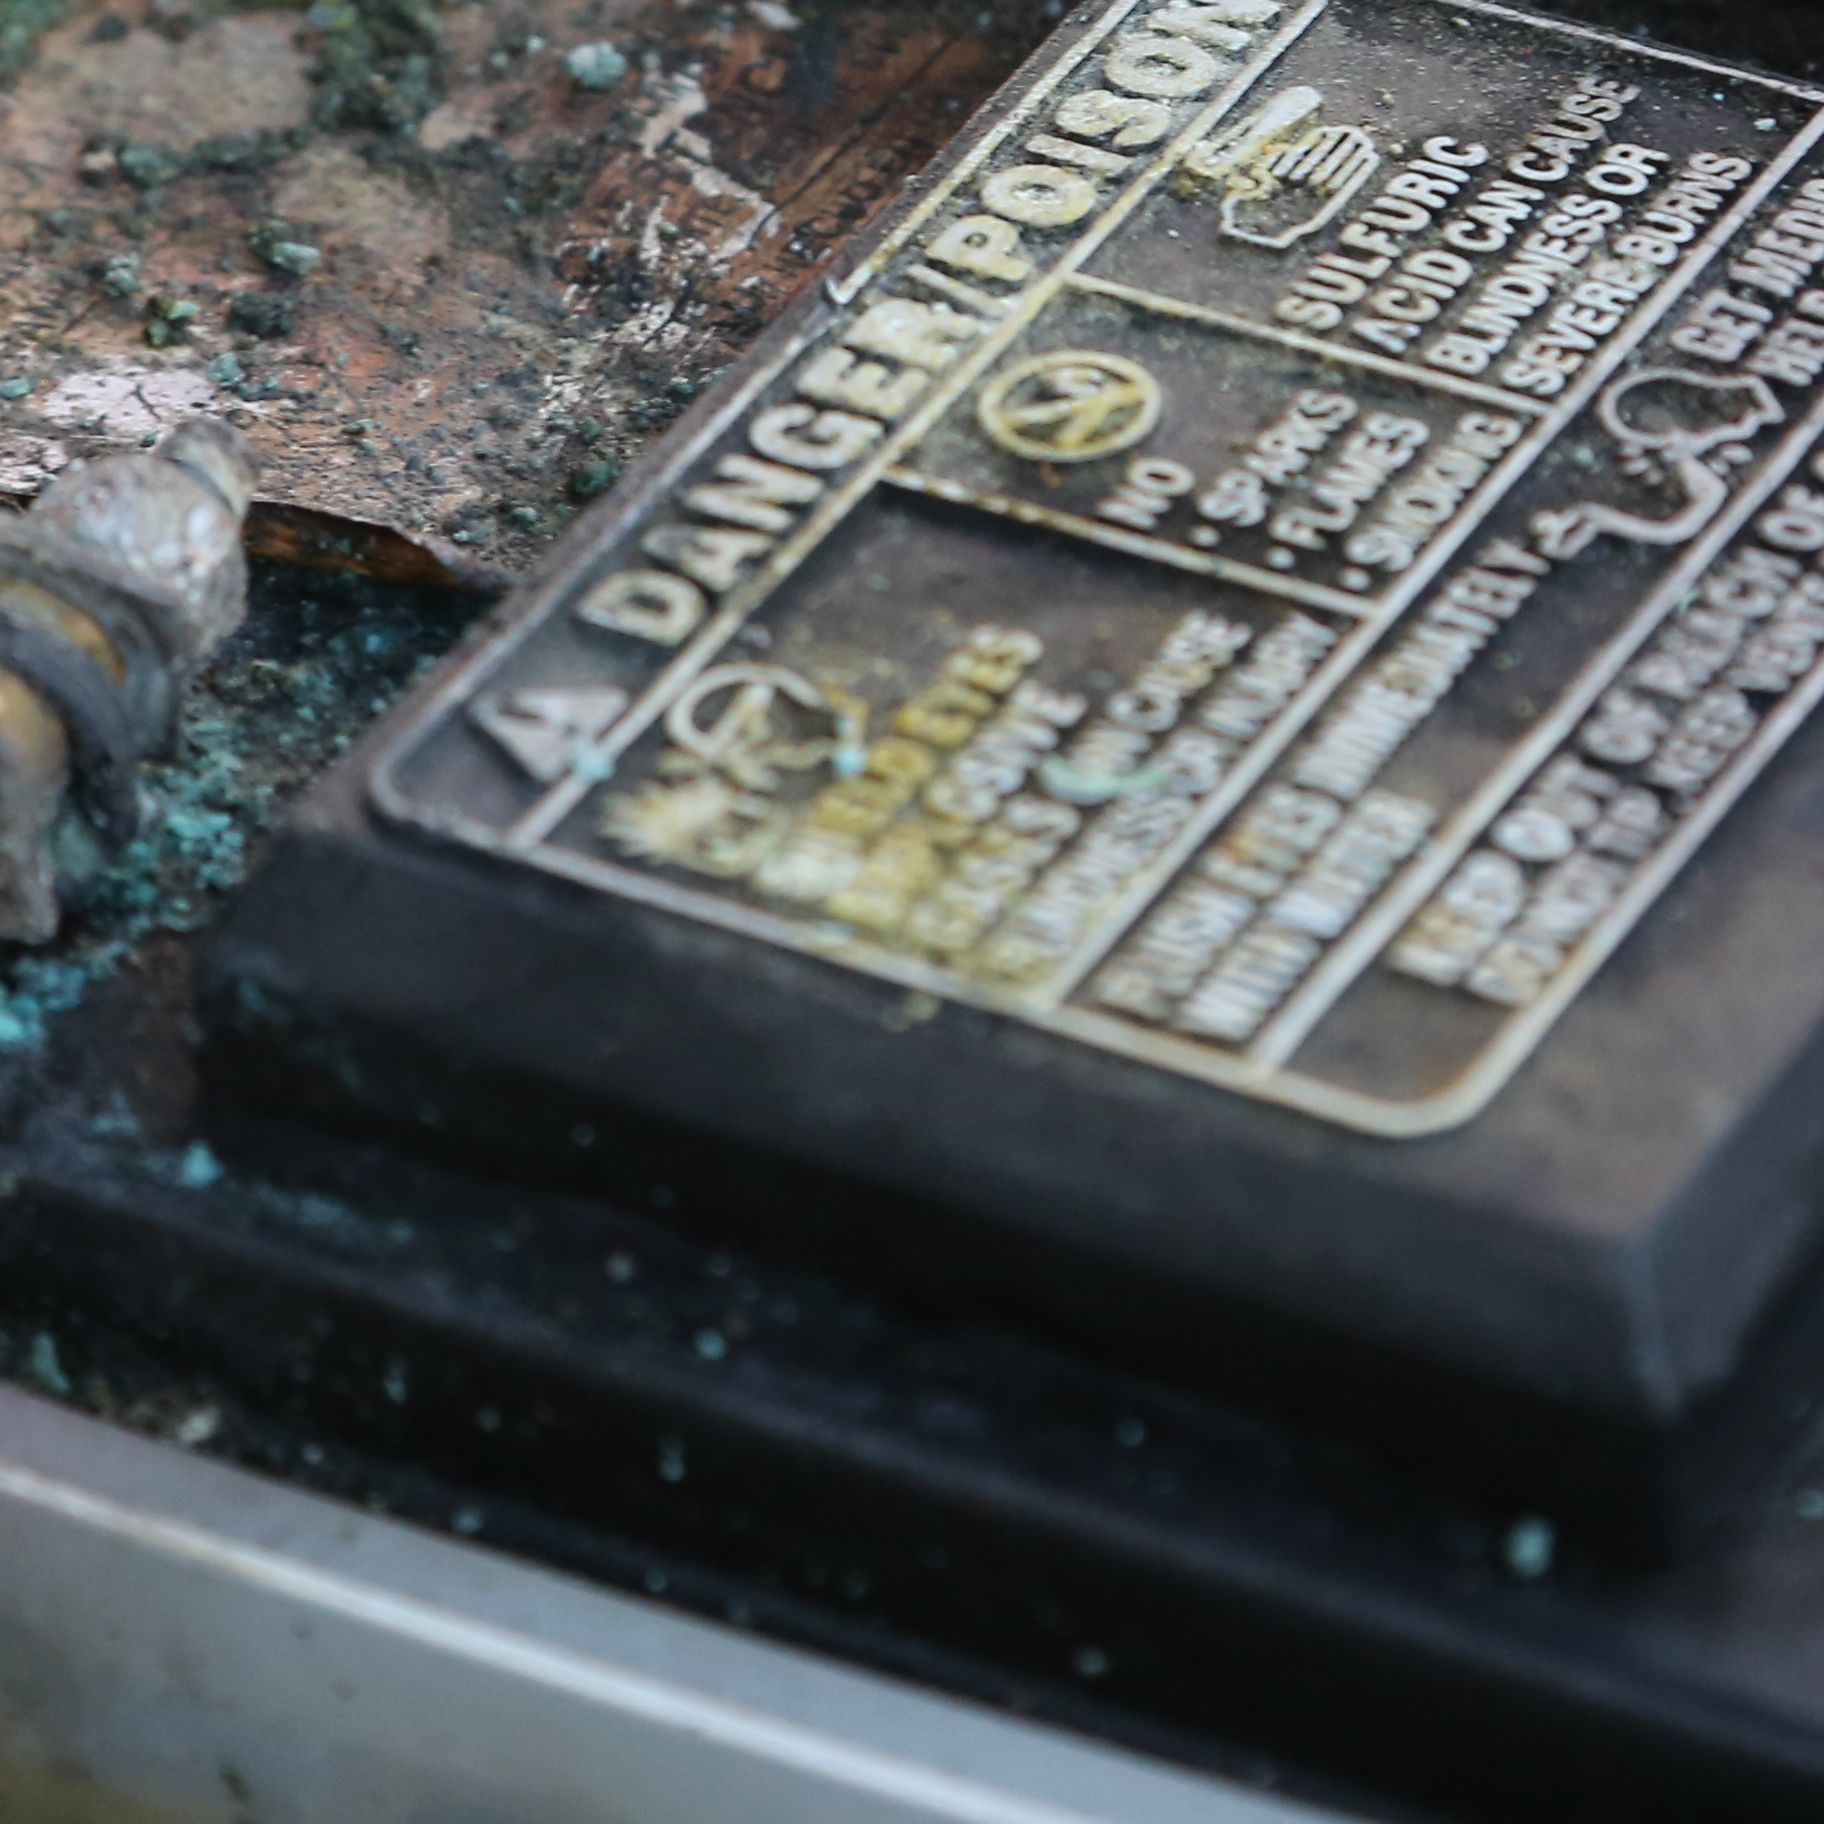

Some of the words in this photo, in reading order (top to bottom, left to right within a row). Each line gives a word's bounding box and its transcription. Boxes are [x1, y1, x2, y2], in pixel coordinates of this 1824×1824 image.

[1269, 131, 1495, 333] SULFURIC
[1341, 243, 1484, 354] ACID
[1435, 177, 1550, 257] CAN
[1499, 72, 1646, 186] CAUSE
[1420, 188, 1630, 377] BLINDNESS
[1577, 138, 1675, 200] OR
[1493, 255, 1664, 399] SEVERE
[1610, 146, 1759, 267] BURNS
[1661, 285, 1784, 366] GET
[1096, 453, 1204, 528] NO
[1187, 382, 1368, 529] SPARKS
[1261, 407, 1439, 552] FLAMES
[1333, 405, 1532, 575] SMOKING
[1621, 543, 1811, 702] REACH
[1560, 684, 1689, 771] OF
[1477, 750, 1634, 868] OUT
